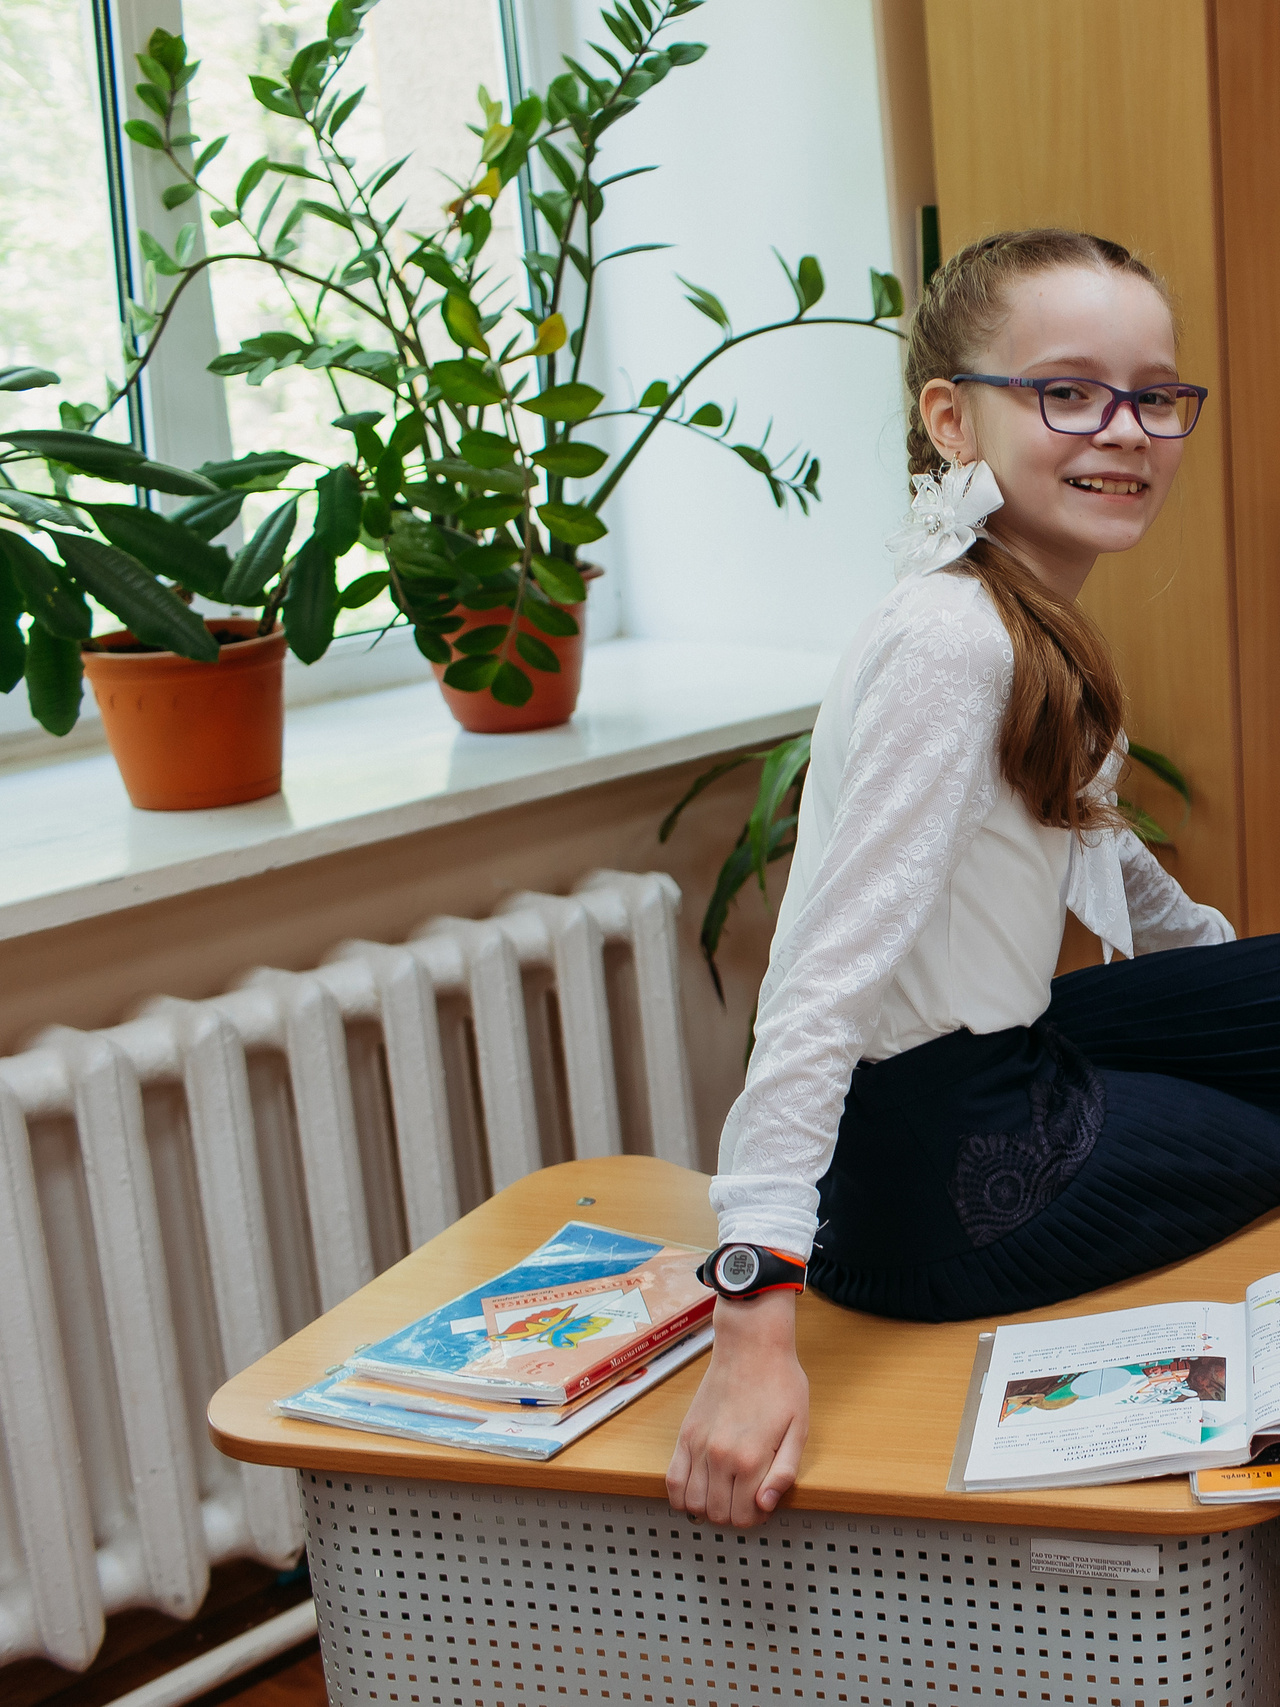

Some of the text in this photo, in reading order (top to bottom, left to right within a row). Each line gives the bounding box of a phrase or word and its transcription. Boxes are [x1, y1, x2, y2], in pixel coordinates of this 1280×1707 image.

[579, 1376, 592, 1390] 3
[609, 1338, 651, 1369] Математика
[1220, 1473, 1251, 1481] Голубь
[1032, 1559, 1074, 1568] ОДНОМЕСТНЫЙ
[1075, 1563, 1106, 1571] РАСТУЩИЙ
[1090, 1557, 1131, 1566] УЧЕНИЧЕСКИЙ
[1032, 1566, 1074, 1574] РЕГУЛИРОВКОЙ
